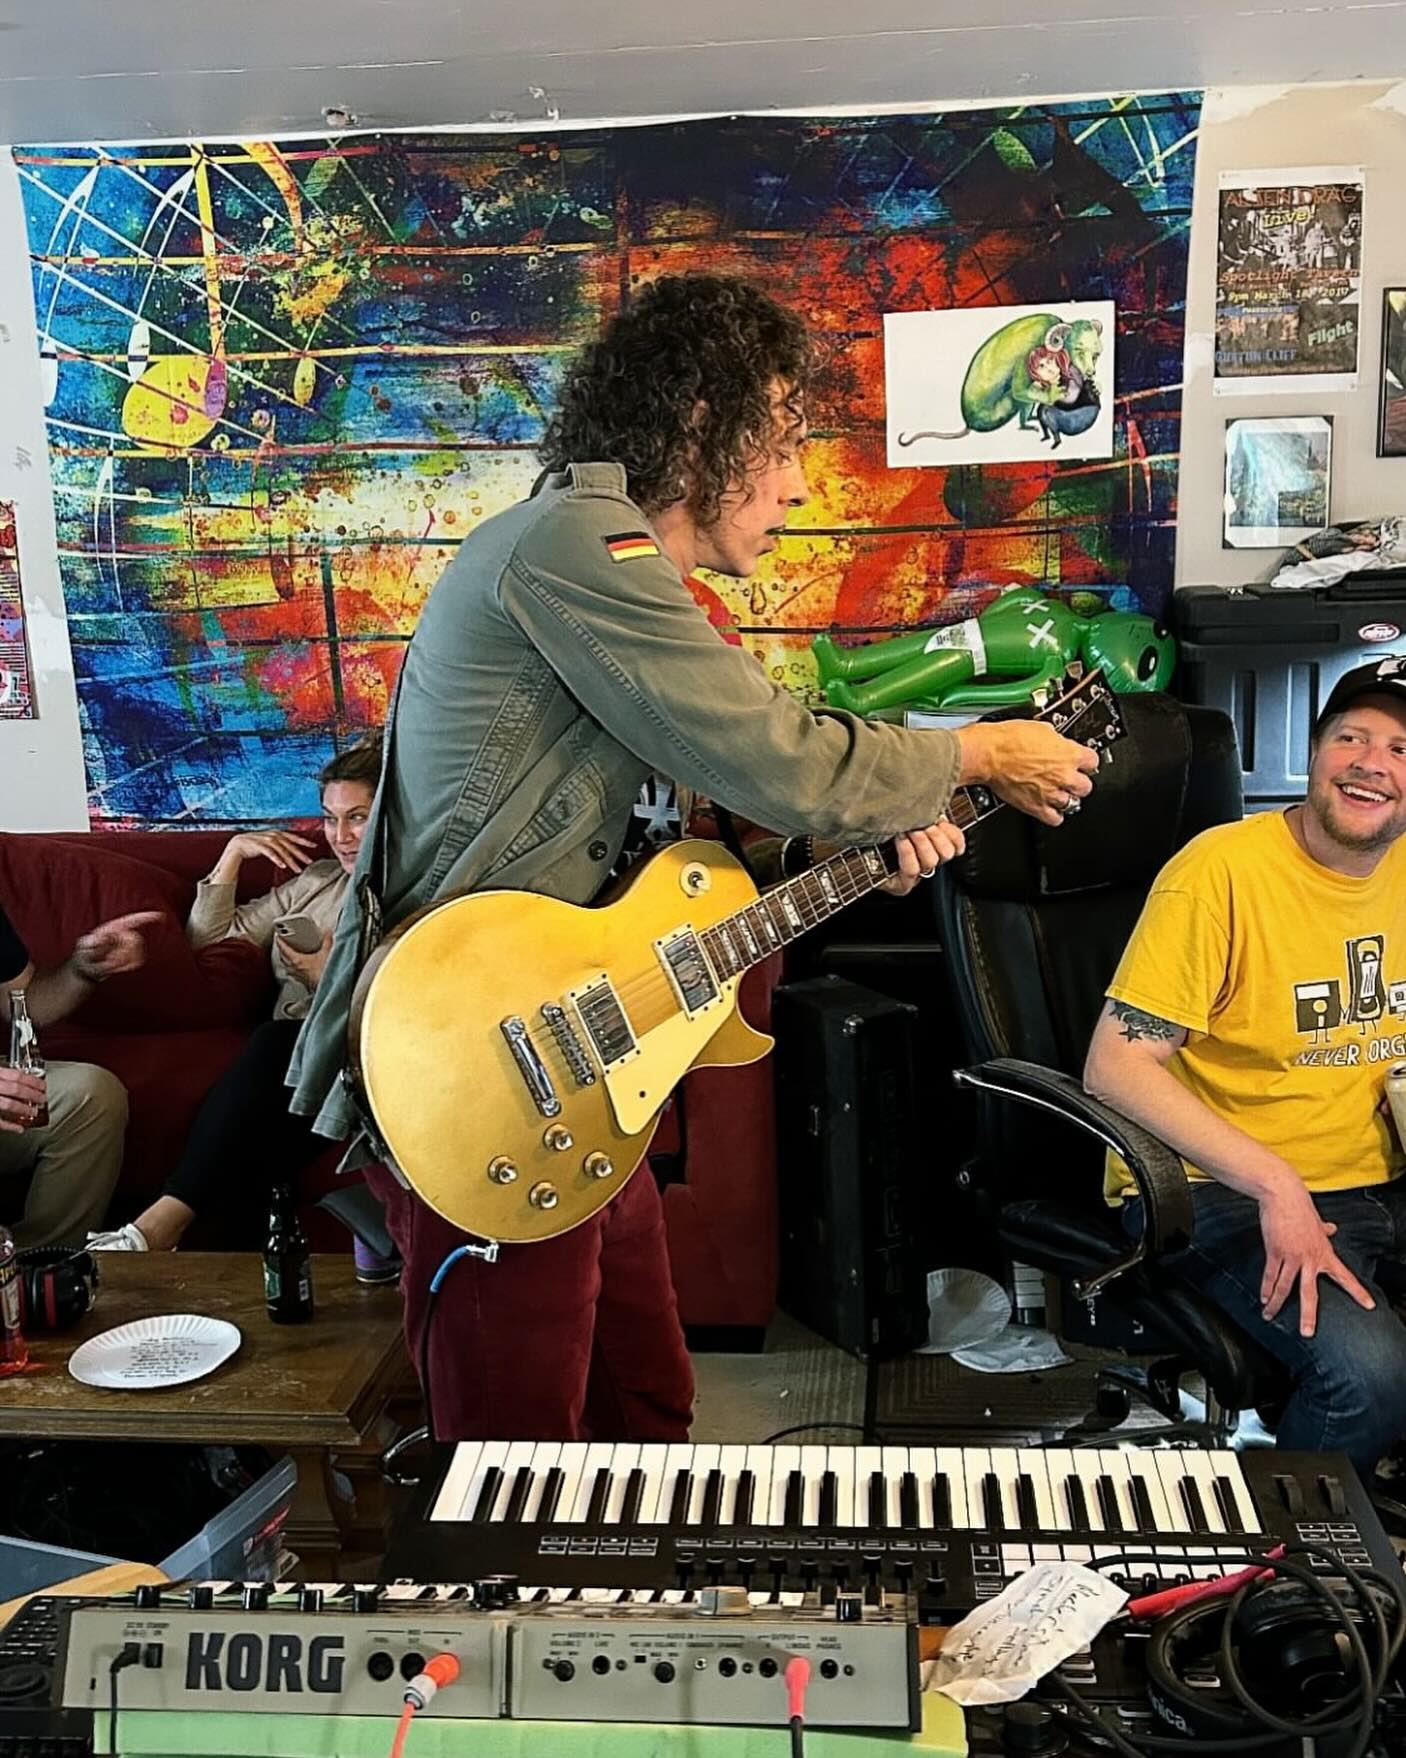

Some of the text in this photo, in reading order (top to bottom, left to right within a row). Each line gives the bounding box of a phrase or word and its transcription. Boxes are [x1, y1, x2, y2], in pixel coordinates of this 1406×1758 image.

[1226, 185, 1356, 207] ALIEN DRAG
[1220, 269, 1297, 284] Spotlight
[1307, 320, 1354, 346] Flight
[1294, 1032, 1406, 1066] NEVER ORG
[185, 1632, 345, 1693] KORG
